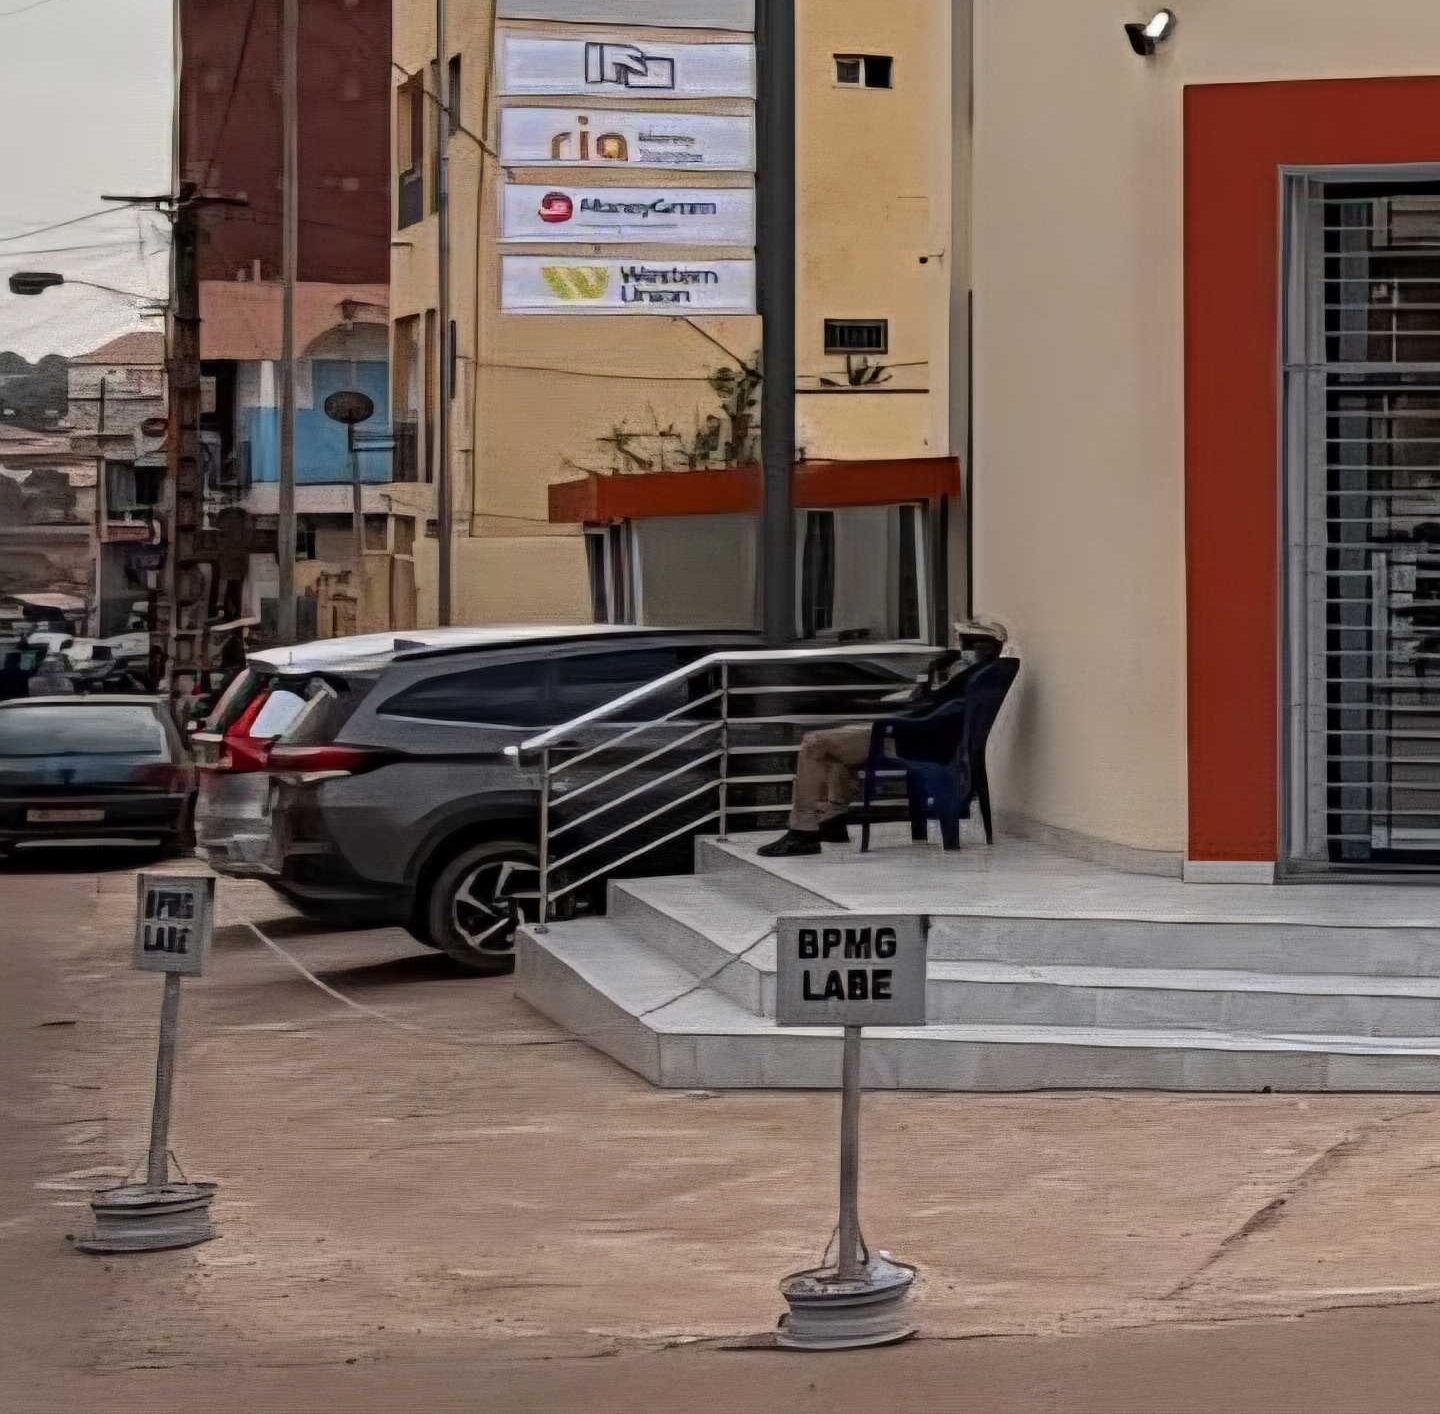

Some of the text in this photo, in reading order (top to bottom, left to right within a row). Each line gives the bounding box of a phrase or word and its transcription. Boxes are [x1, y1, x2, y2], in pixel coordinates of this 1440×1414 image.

[551, 115, 629, 161] ria
[798, 927, 898, 960] BPMG
[802, 969, 893, 1001] LABE
